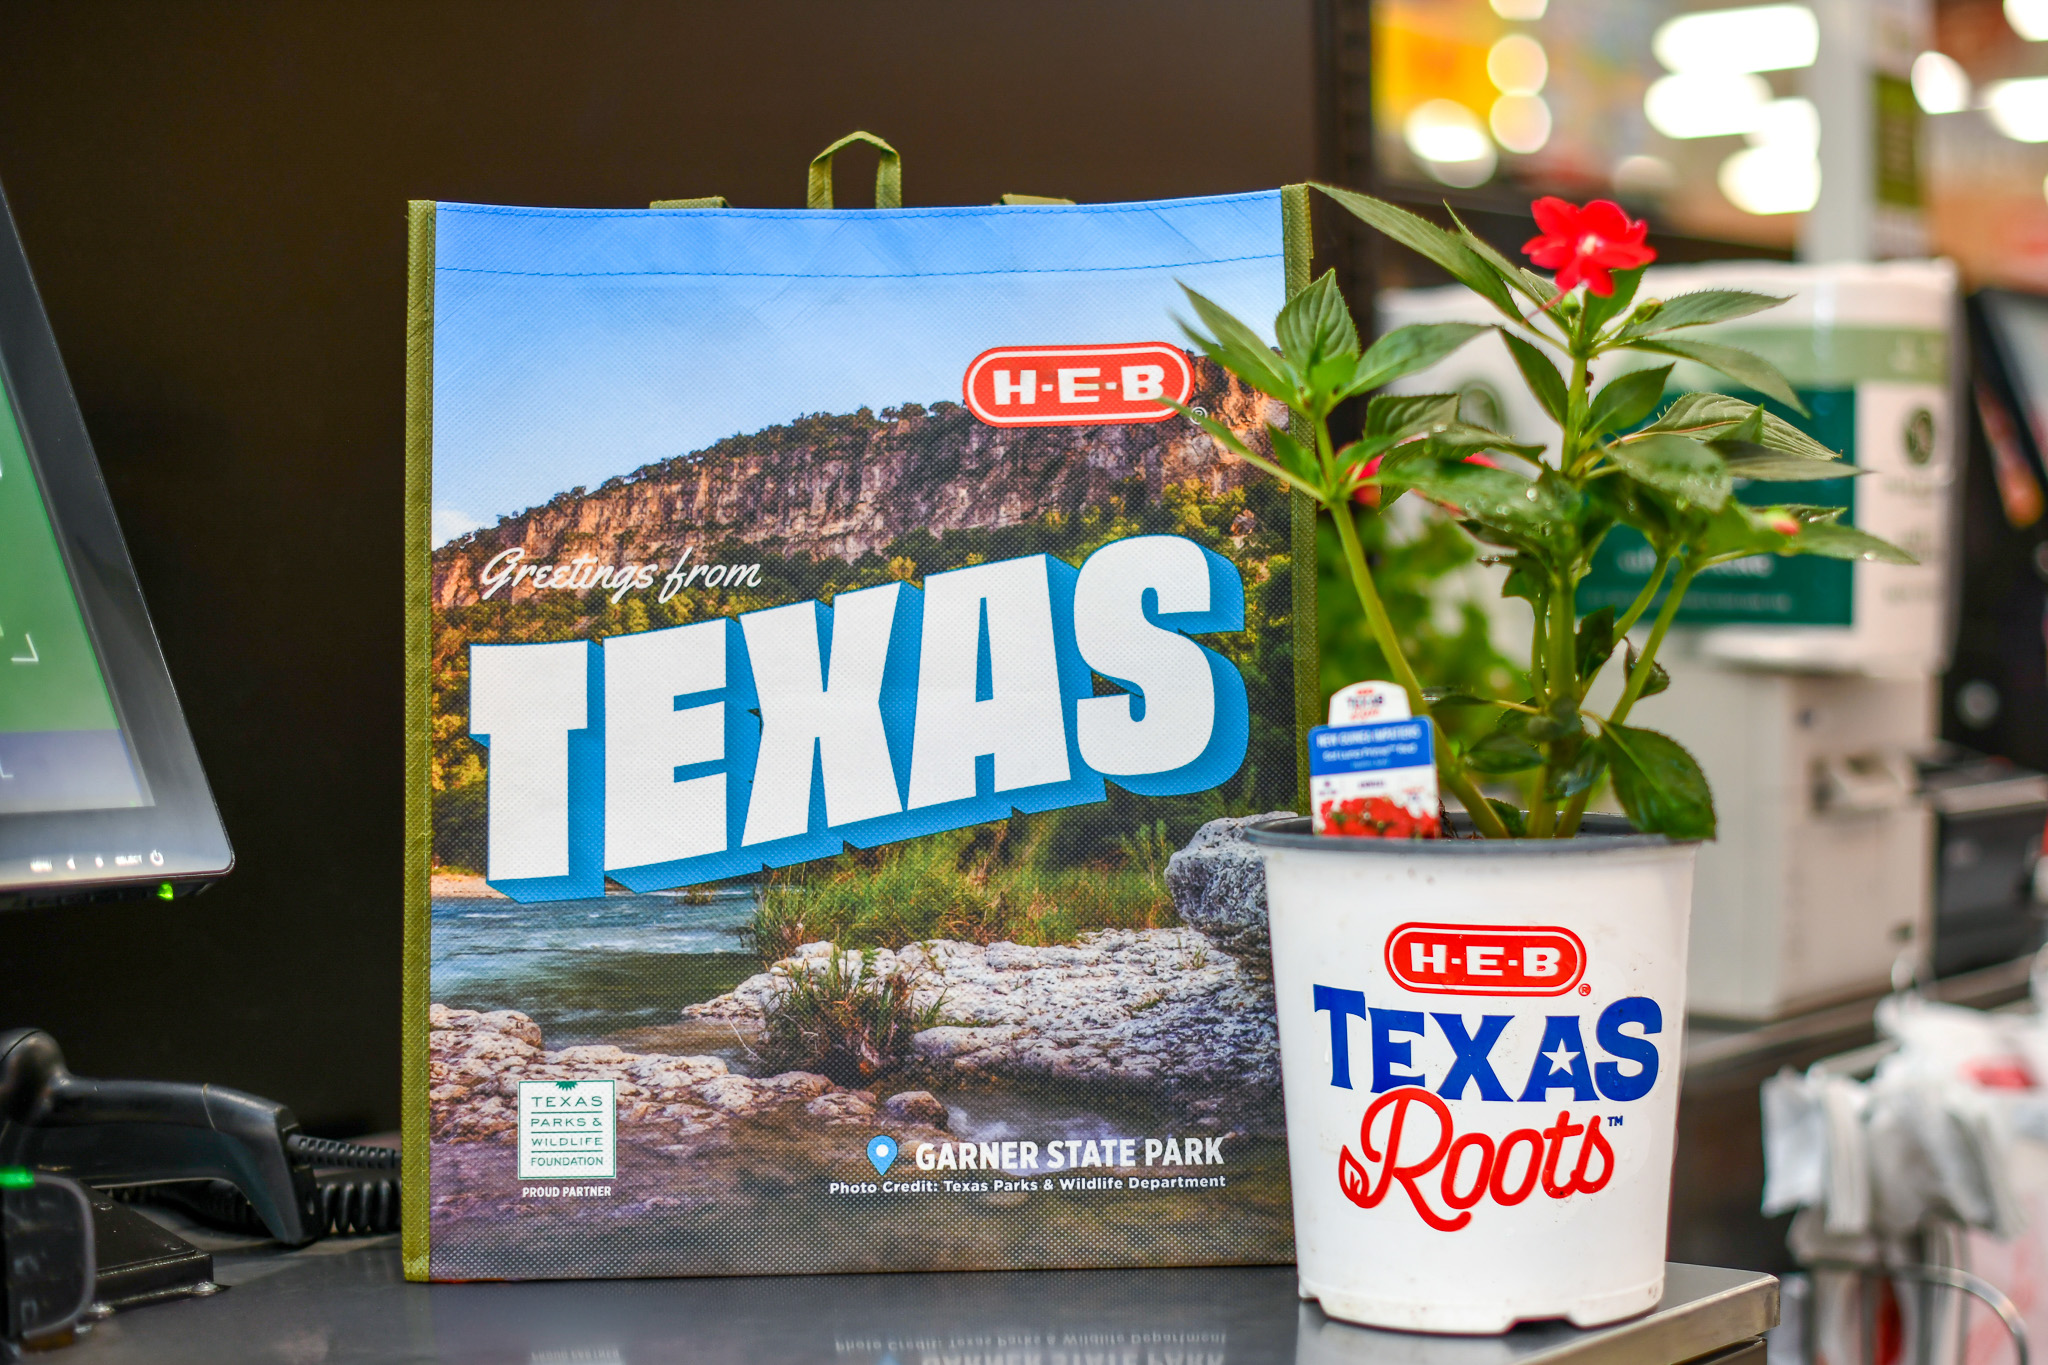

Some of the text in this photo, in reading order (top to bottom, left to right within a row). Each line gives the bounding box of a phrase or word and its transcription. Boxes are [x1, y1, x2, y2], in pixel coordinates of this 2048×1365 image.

[993, 365, 1165, 405] H-E-B
[482, 546, 762, 604] Greetings from
[469, 534, 1249, 904] TEXAS
[1409, 942, 1562, 978] H-E-B
[1313, 984, 1663, 1102] TEXAS
[531, 1096, 603, 1108] TEXAS
[531, 1117, 603, 1127] PARKS &
[531, 1137, 603, 1147] WILDLIFE
[915, 1136, 1225, 1171] GARNER STATE PARK
[1338, 1087, 1615, 1232] Roots
[531, 1156, 604, 1167] FOUNDATION
[522, 1185, 612, 1198] PROUD PARTNER
[829, 1175, 1227, 1195] Photo Credit: Texas Parks & Wildlife Department
